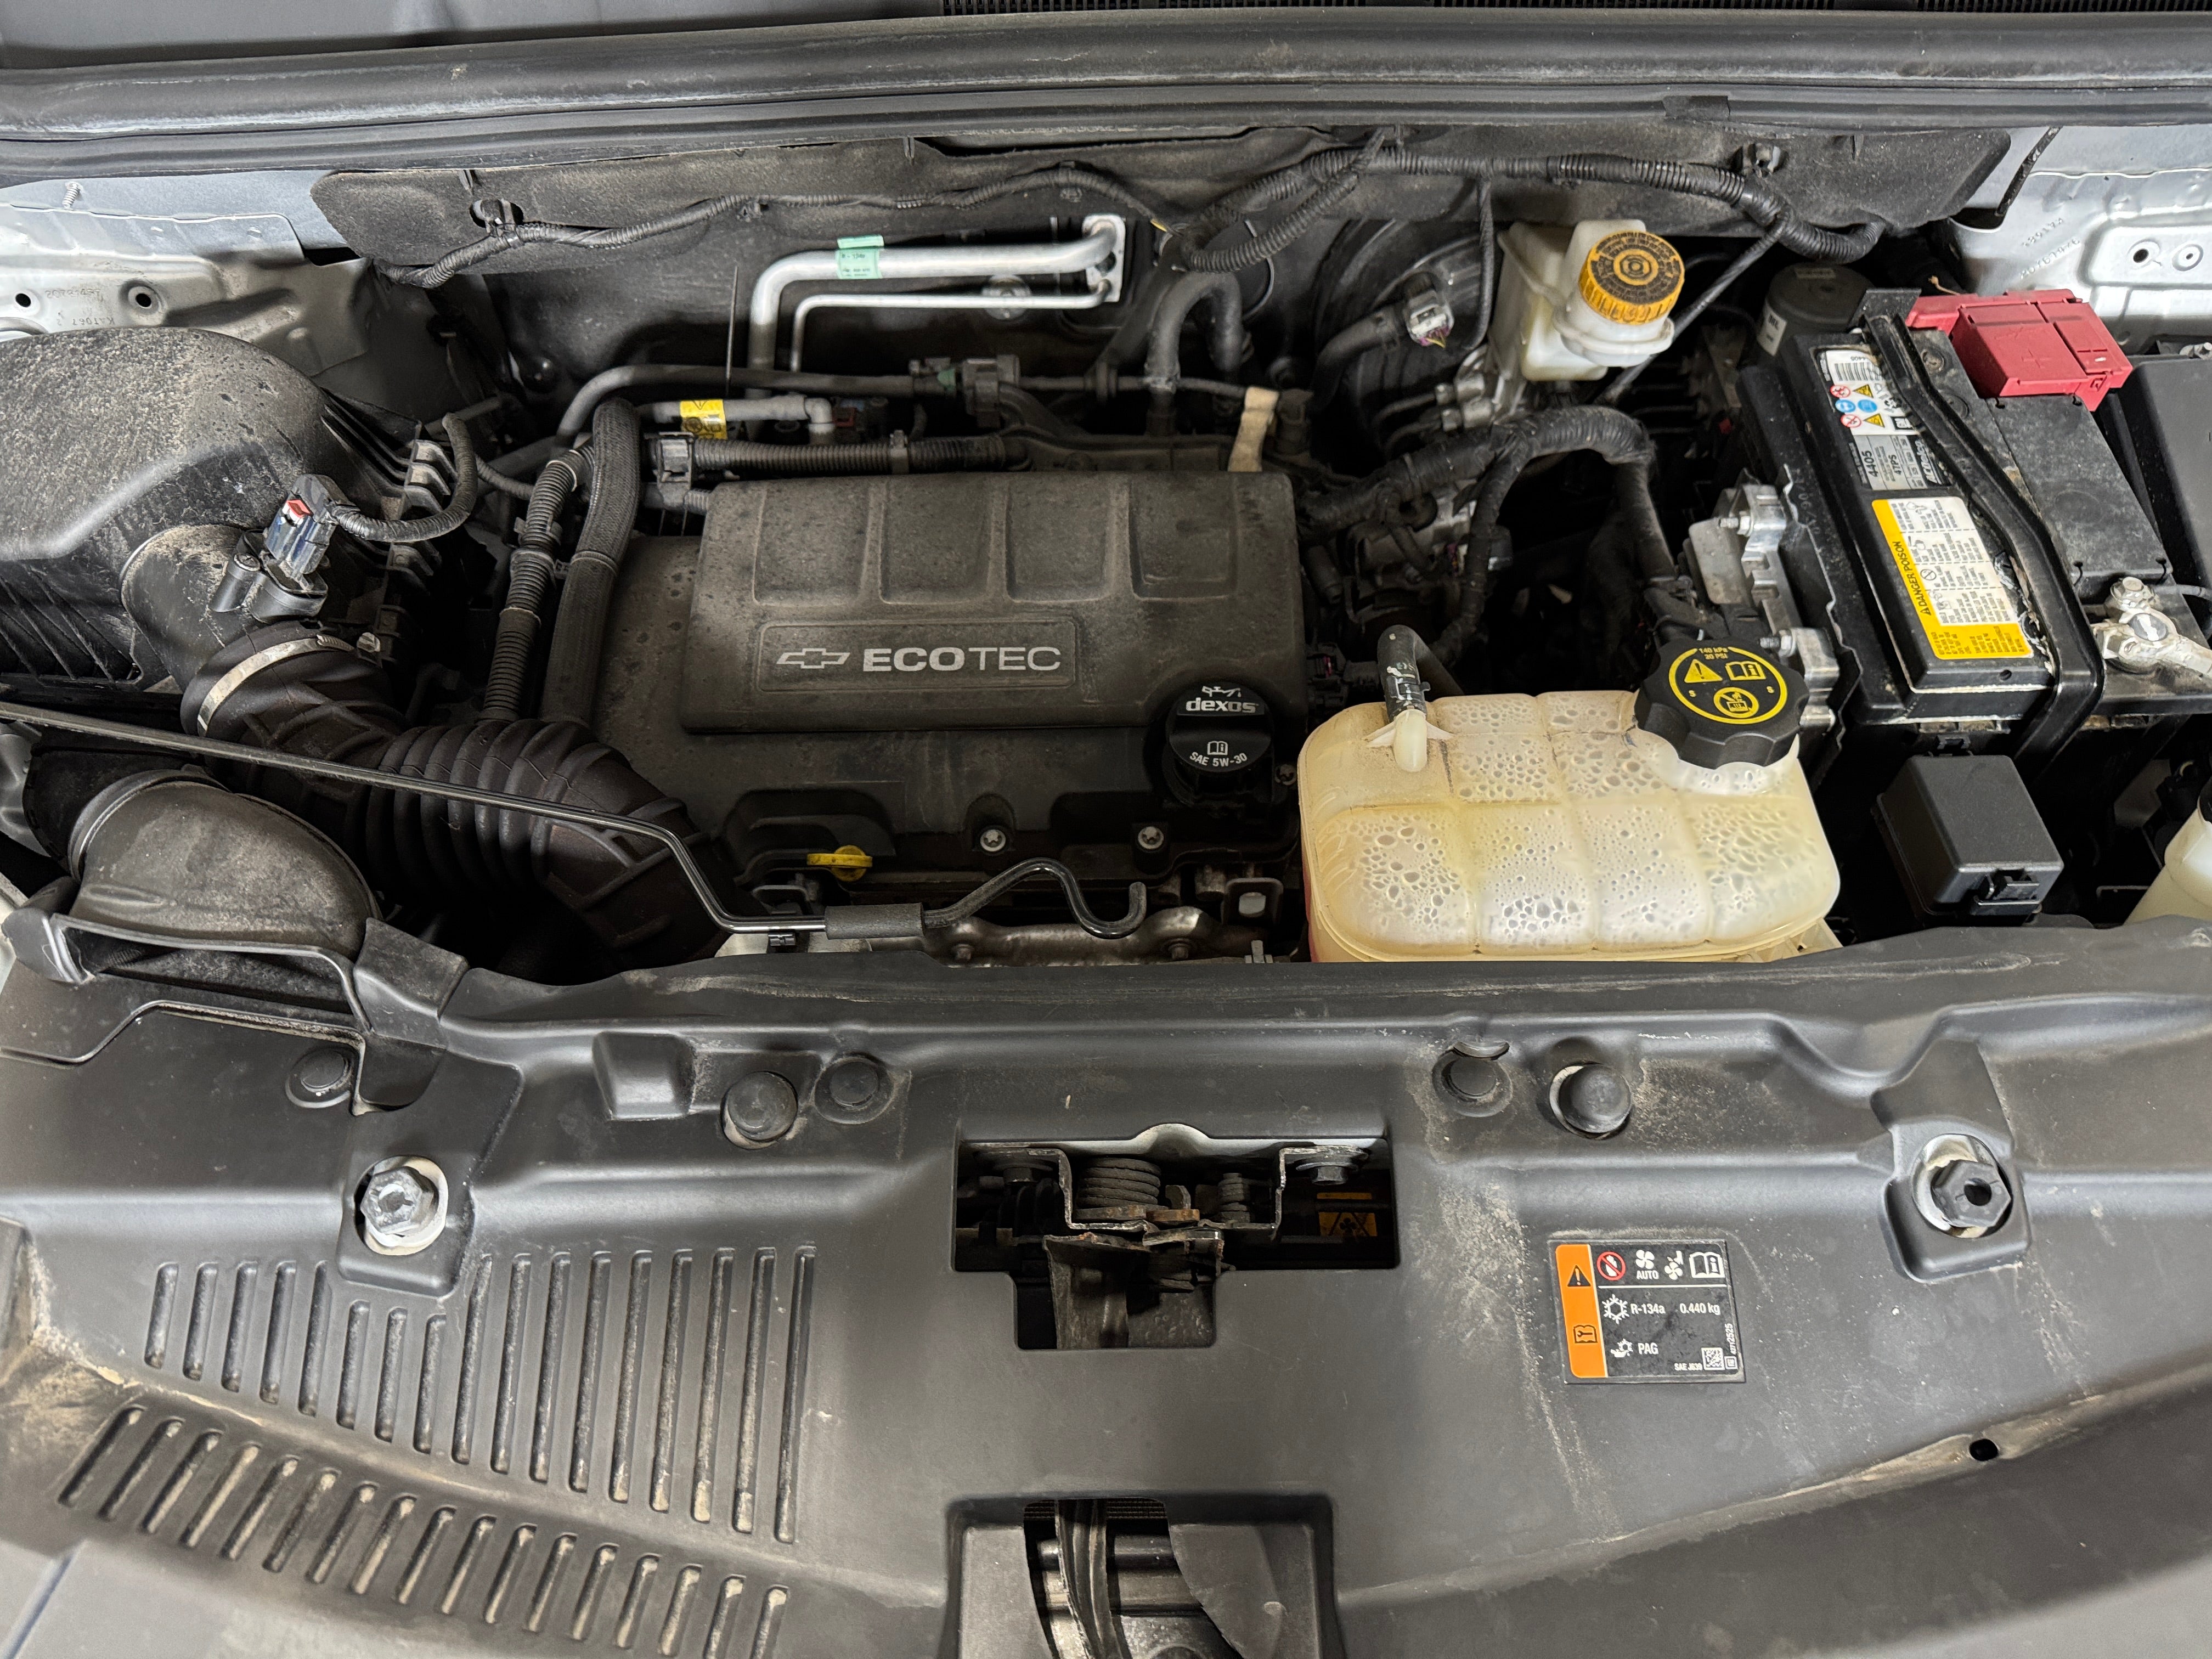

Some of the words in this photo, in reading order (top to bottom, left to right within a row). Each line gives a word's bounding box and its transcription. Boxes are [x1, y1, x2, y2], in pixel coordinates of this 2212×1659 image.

[1861, 450, 1878, 477] 4405
[1892, 541, 1914, 573] POISON
[1906, 572, 1928, 610] DANGER
[863, 647, 1061, 672] ECOTEC
[1186, 697, 1256, 713] dexos
[1189, 752, 1210, 766] SAE
[1212, 753, 1248, 767] 5W-30
[1636, 1269, 1659, 1280] AUTO
[1631, 1304, 1666, 1314] R-134a
[1680, 1303, 1706, 1314] 0.440
[1708, 1302, 1721, 1316] kg
[1638, 1342, 1659, 1355] PAG
[1674, 1363, 1688, 1372] SAE
